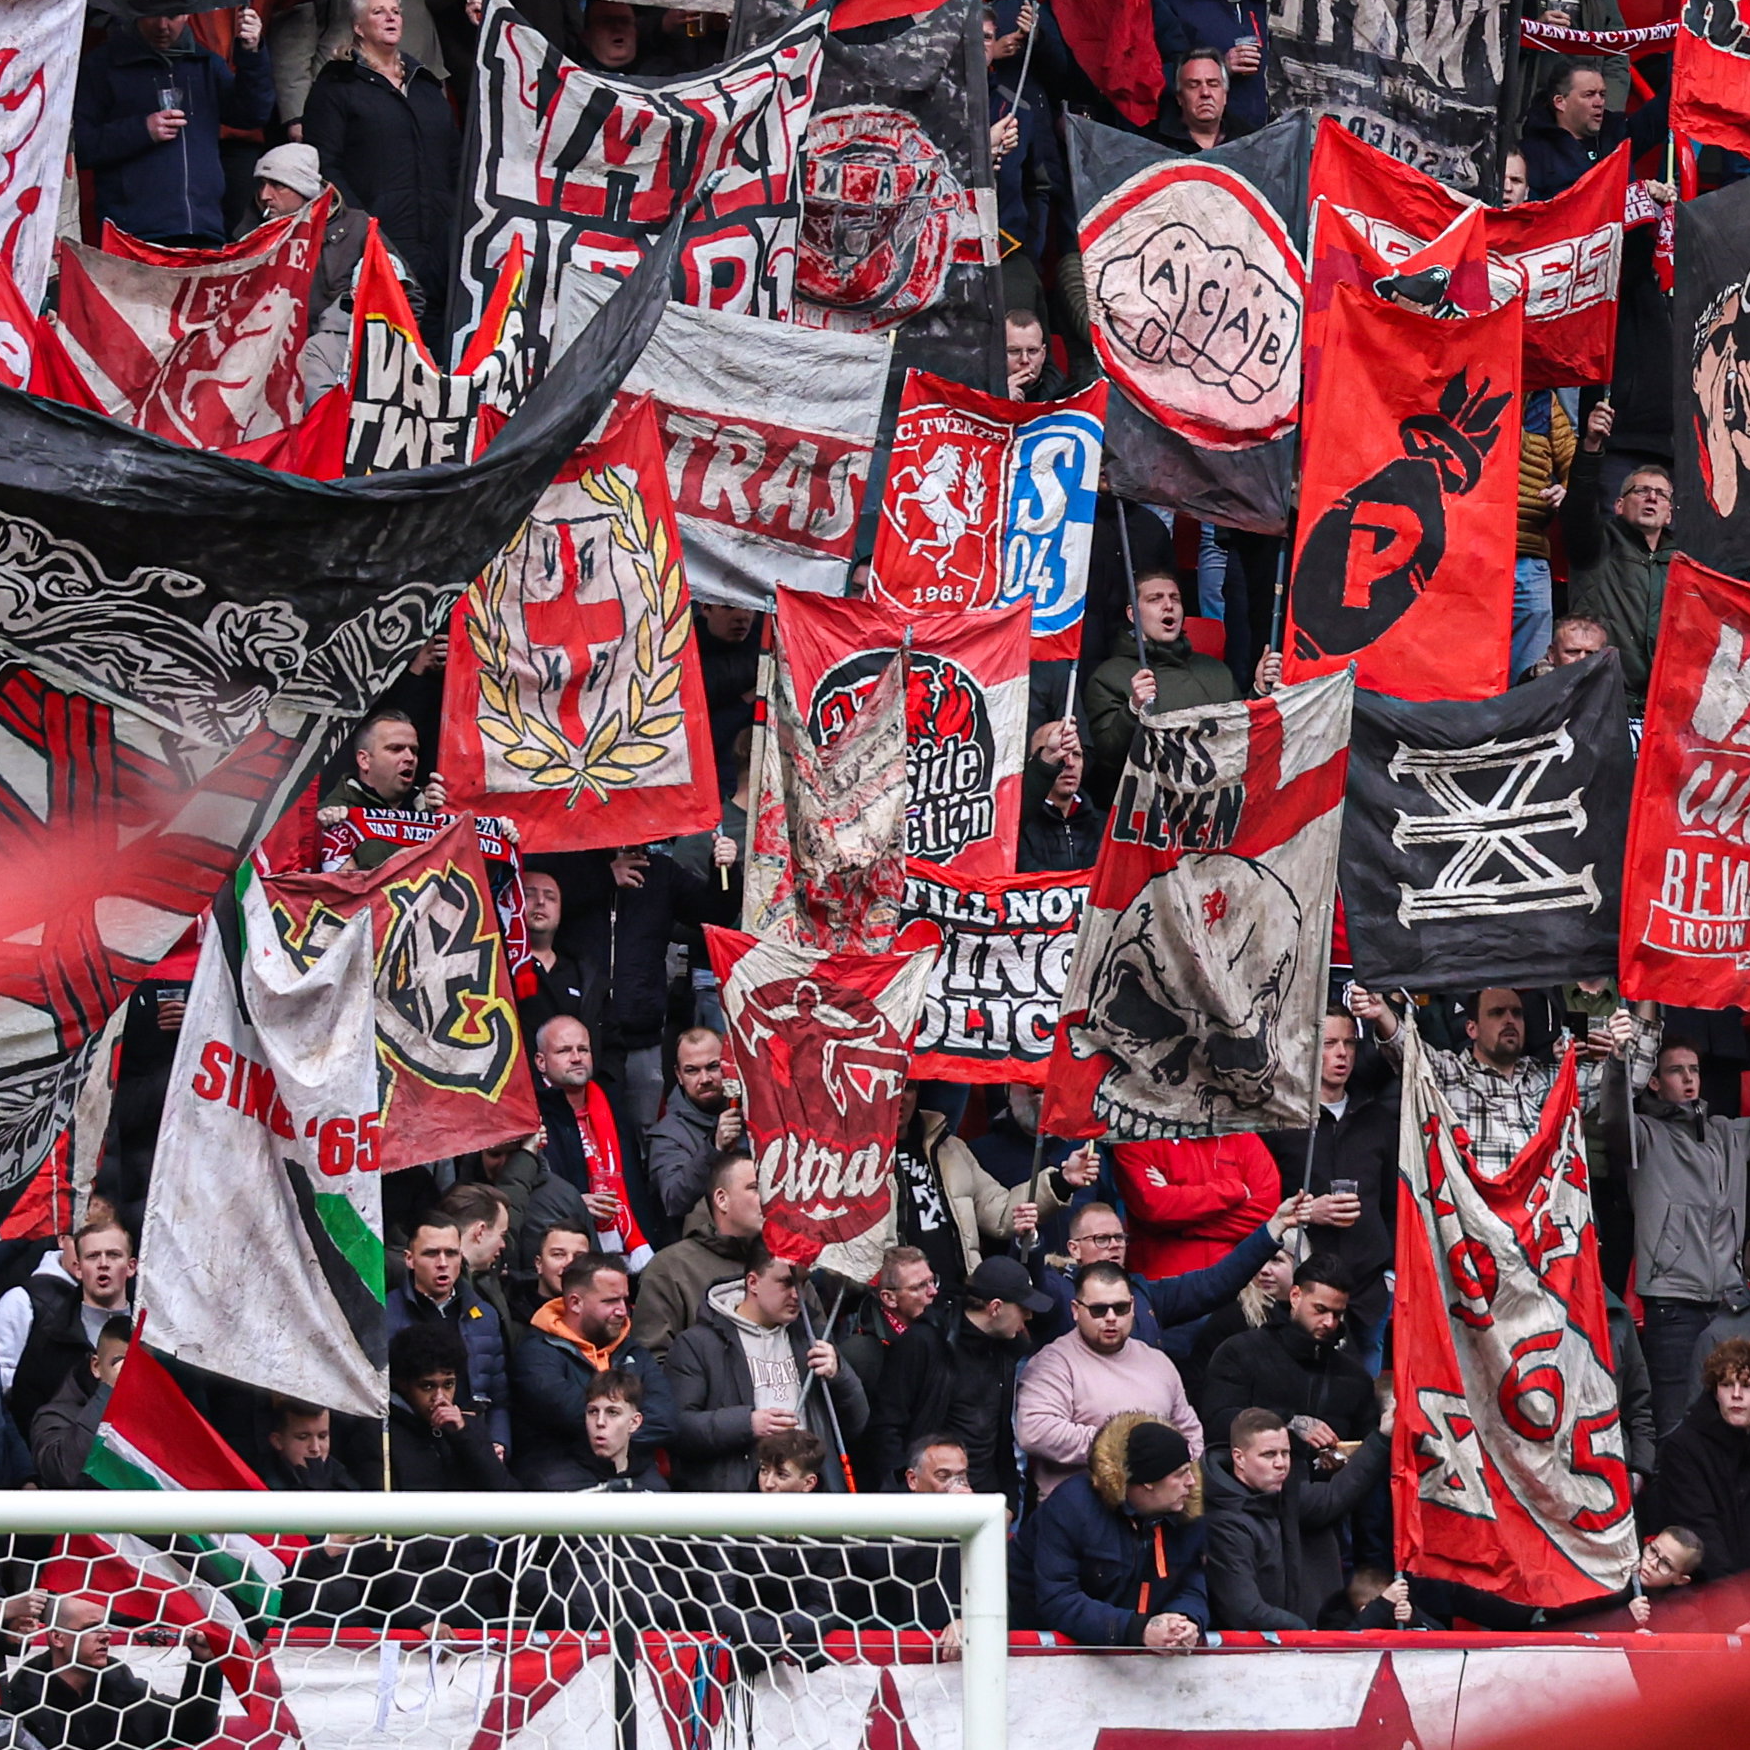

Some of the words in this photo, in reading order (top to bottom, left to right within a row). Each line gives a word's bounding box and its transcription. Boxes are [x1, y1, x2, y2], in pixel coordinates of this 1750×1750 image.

[917, 415, 1007, 444] TWENTE
[1014, 435, 1077, 536] S
[1003, 534, 1055, 604] 04
[1341, 500, 1424, 609] P
[911, 584, 964, 604] 1965
[366, 821, 397, 836] VAN
[1667, 917, 1746, 947] TROUW
